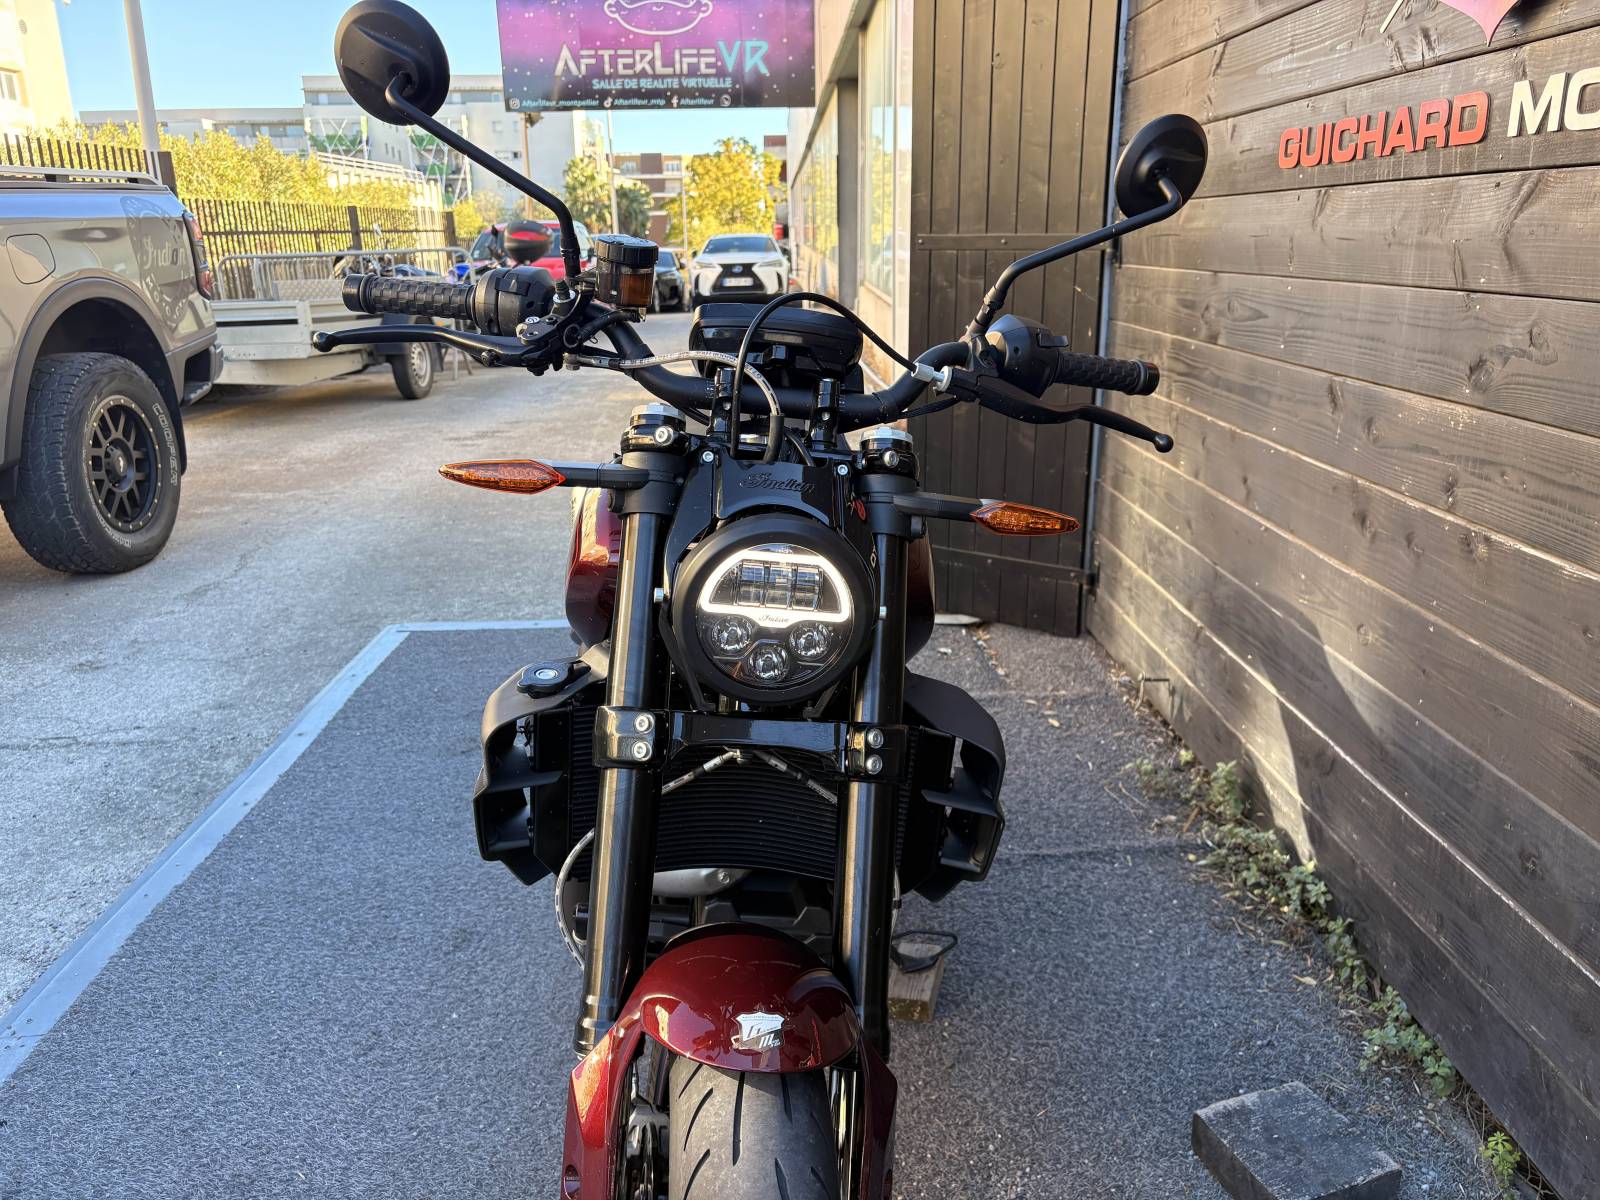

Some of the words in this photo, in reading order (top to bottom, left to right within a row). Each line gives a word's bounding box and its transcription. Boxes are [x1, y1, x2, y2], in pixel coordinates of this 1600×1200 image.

[592, 78, 624, 89] SALLE
[624, 78, 638, 89] DE
[681, 77, 733, 88] VIRTUELLE
[1278, 91, 1490, 169] GUICHARD
[152, 403, 178, 486] COOPER
